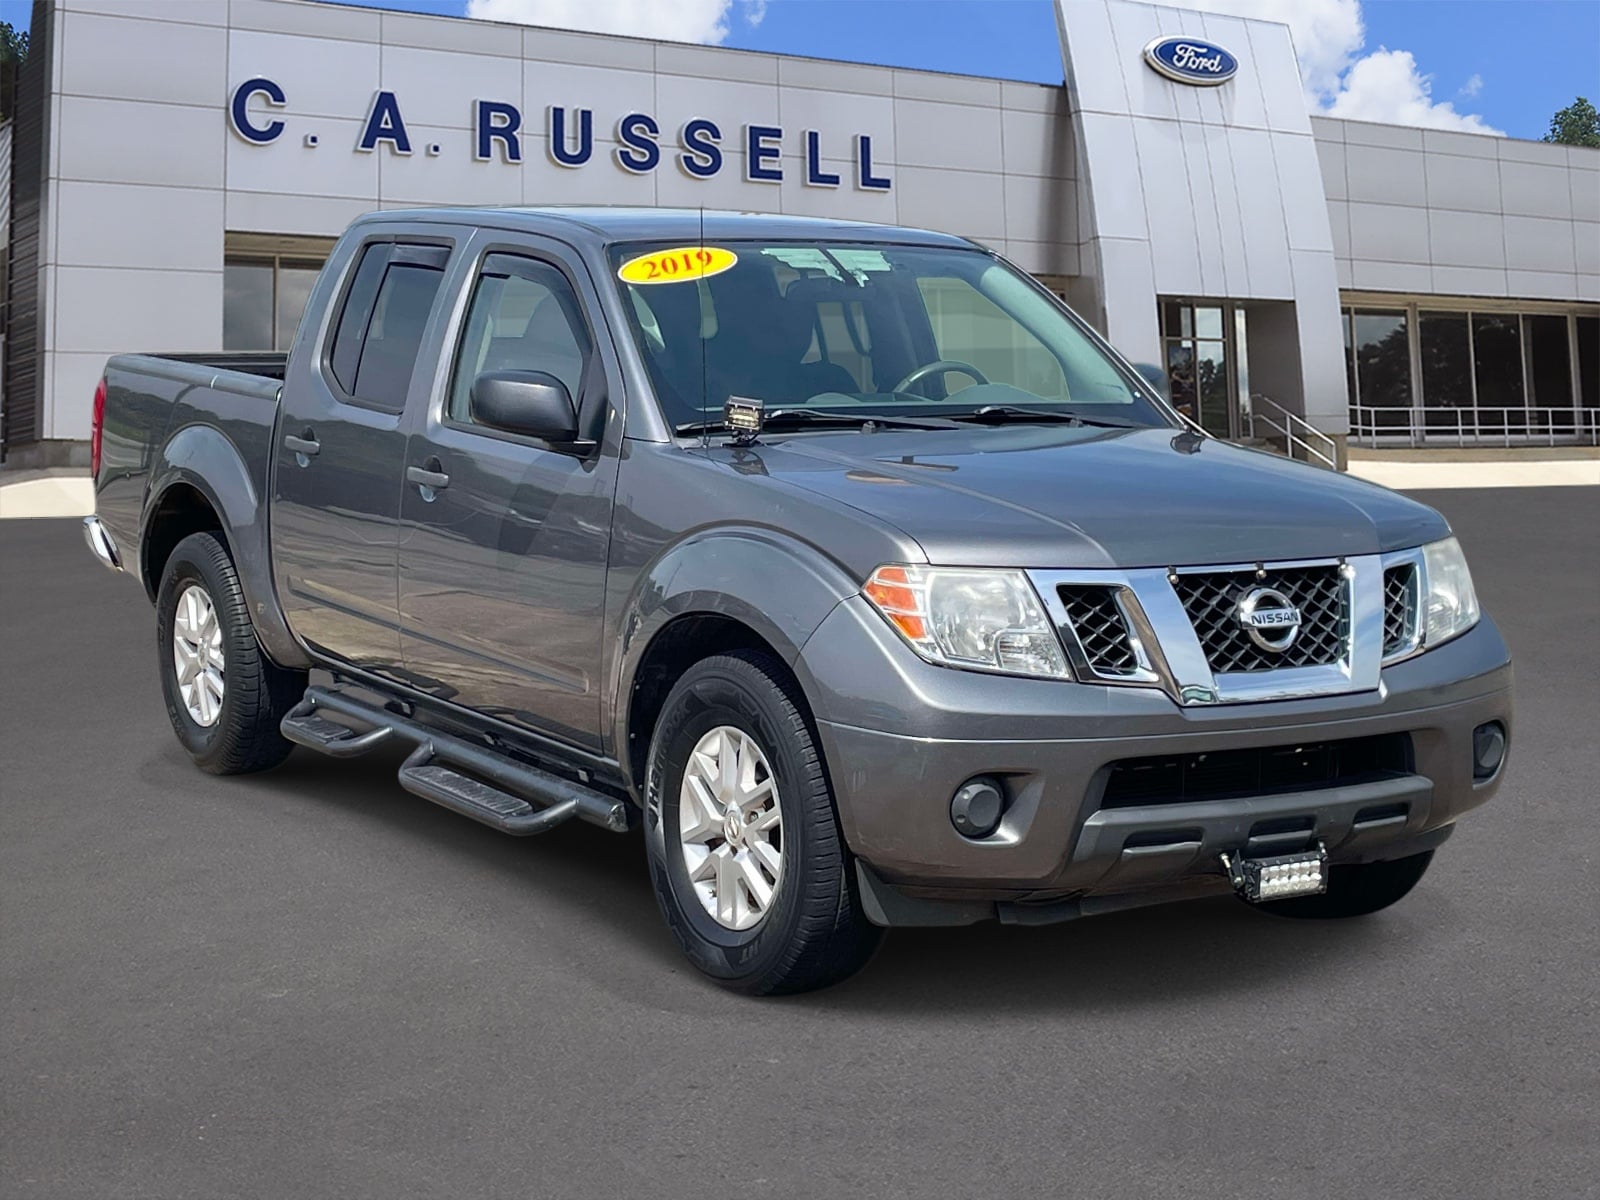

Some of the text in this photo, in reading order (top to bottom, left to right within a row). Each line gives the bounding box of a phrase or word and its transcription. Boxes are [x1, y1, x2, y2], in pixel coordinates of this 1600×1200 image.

[1173, 44, 1222, 72] Ford
[474, 98, 892, 192] RUSSELL
[642, 250, 713, 280] 2019
[1251, 611, 1299, 625] NISSAN
